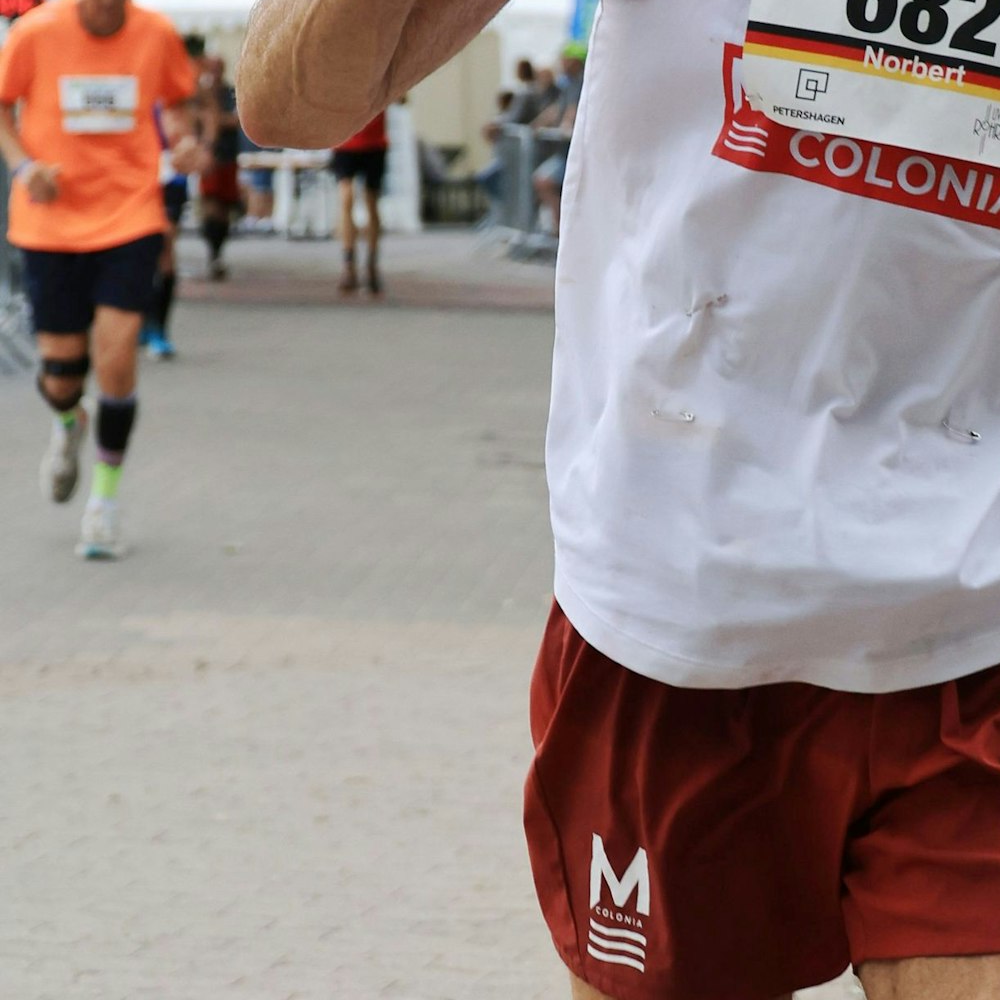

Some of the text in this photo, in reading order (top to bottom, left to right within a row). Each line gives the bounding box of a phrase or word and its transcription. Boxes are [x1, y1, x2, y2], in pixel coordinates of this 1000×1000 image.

[863, 45, 966, 87] Norbert
[773, 105, 845, 125] PETERSHAGEN
[590, 832, 650, 916] M
[595, 906, 643, 928] COLONIA
